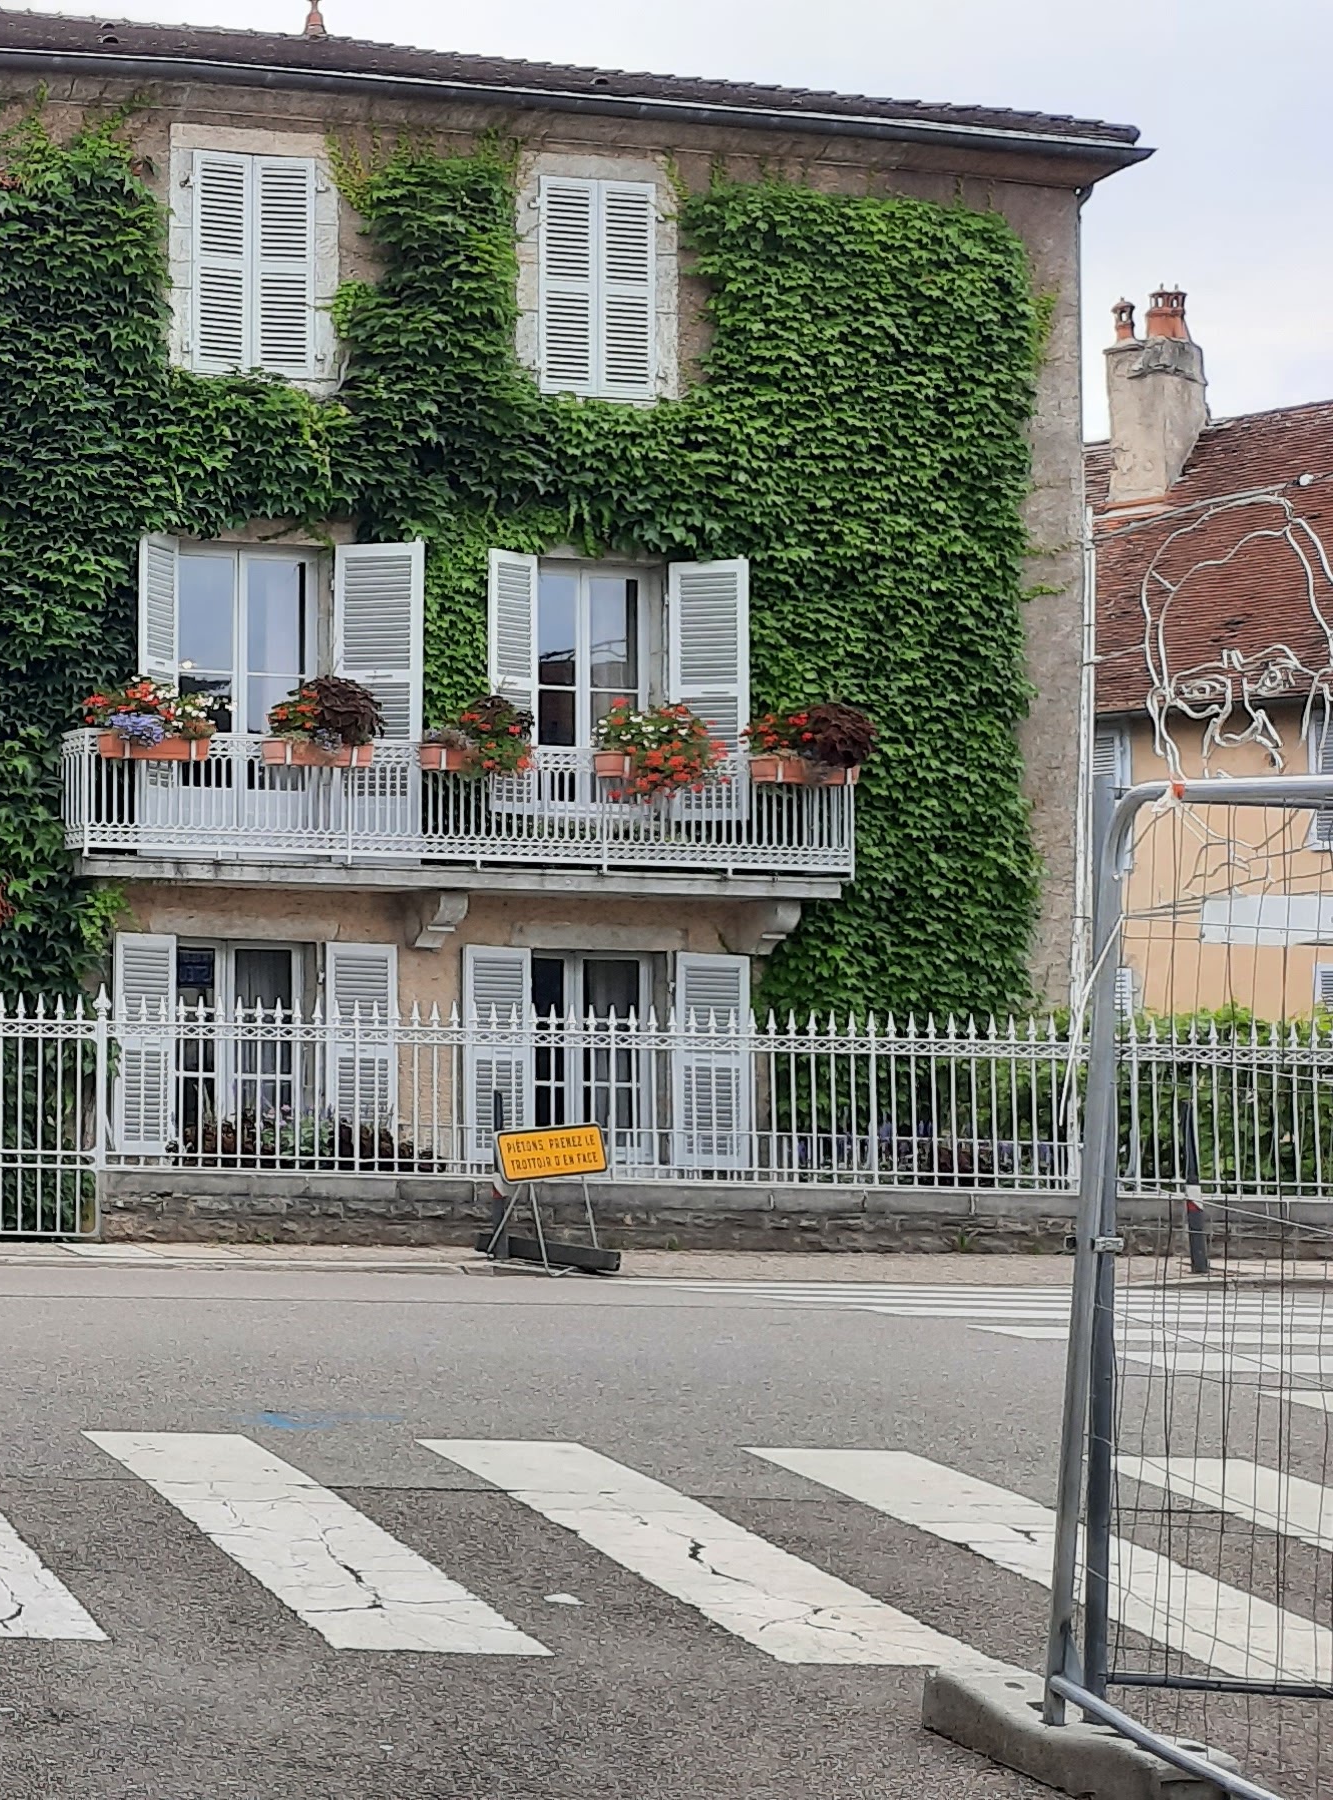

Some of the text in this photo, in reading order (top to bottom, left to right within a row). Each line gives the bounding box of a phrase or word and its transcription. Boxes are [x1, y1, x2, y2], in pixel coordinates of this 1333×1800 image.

[507, 1134, 595, 1154] PIÉTONS PRENEZ LE
[511, 1156, 553, 1172] TROTTOIR
[576, 1151, 598, 1164] FACE
